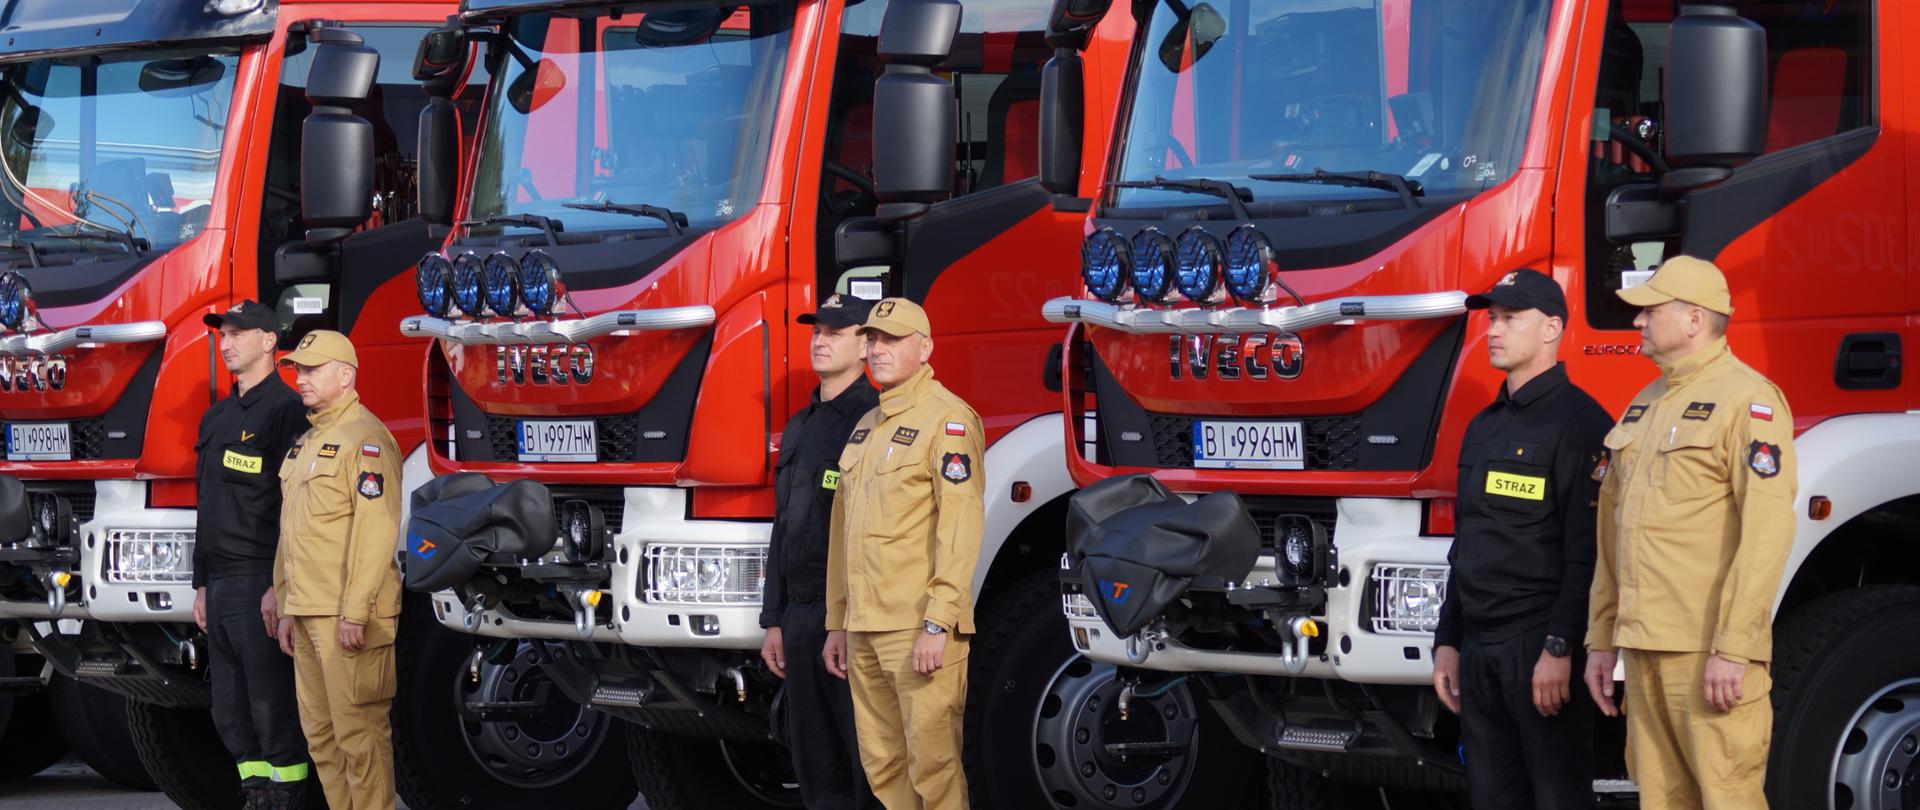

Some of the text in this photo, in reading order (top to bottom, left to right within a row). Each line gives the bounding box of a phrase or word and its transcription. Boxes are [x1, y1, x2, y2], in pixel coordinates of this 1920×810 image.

[497, 343, 593, 385] IVECO
[1169, 332, 1304, 379] IVECO
[13, 427, 68, 452] BI 998HM
[525, 424, 593, 452] BI 997HM
[1205, 425, 1299, 458] BI 996HM
